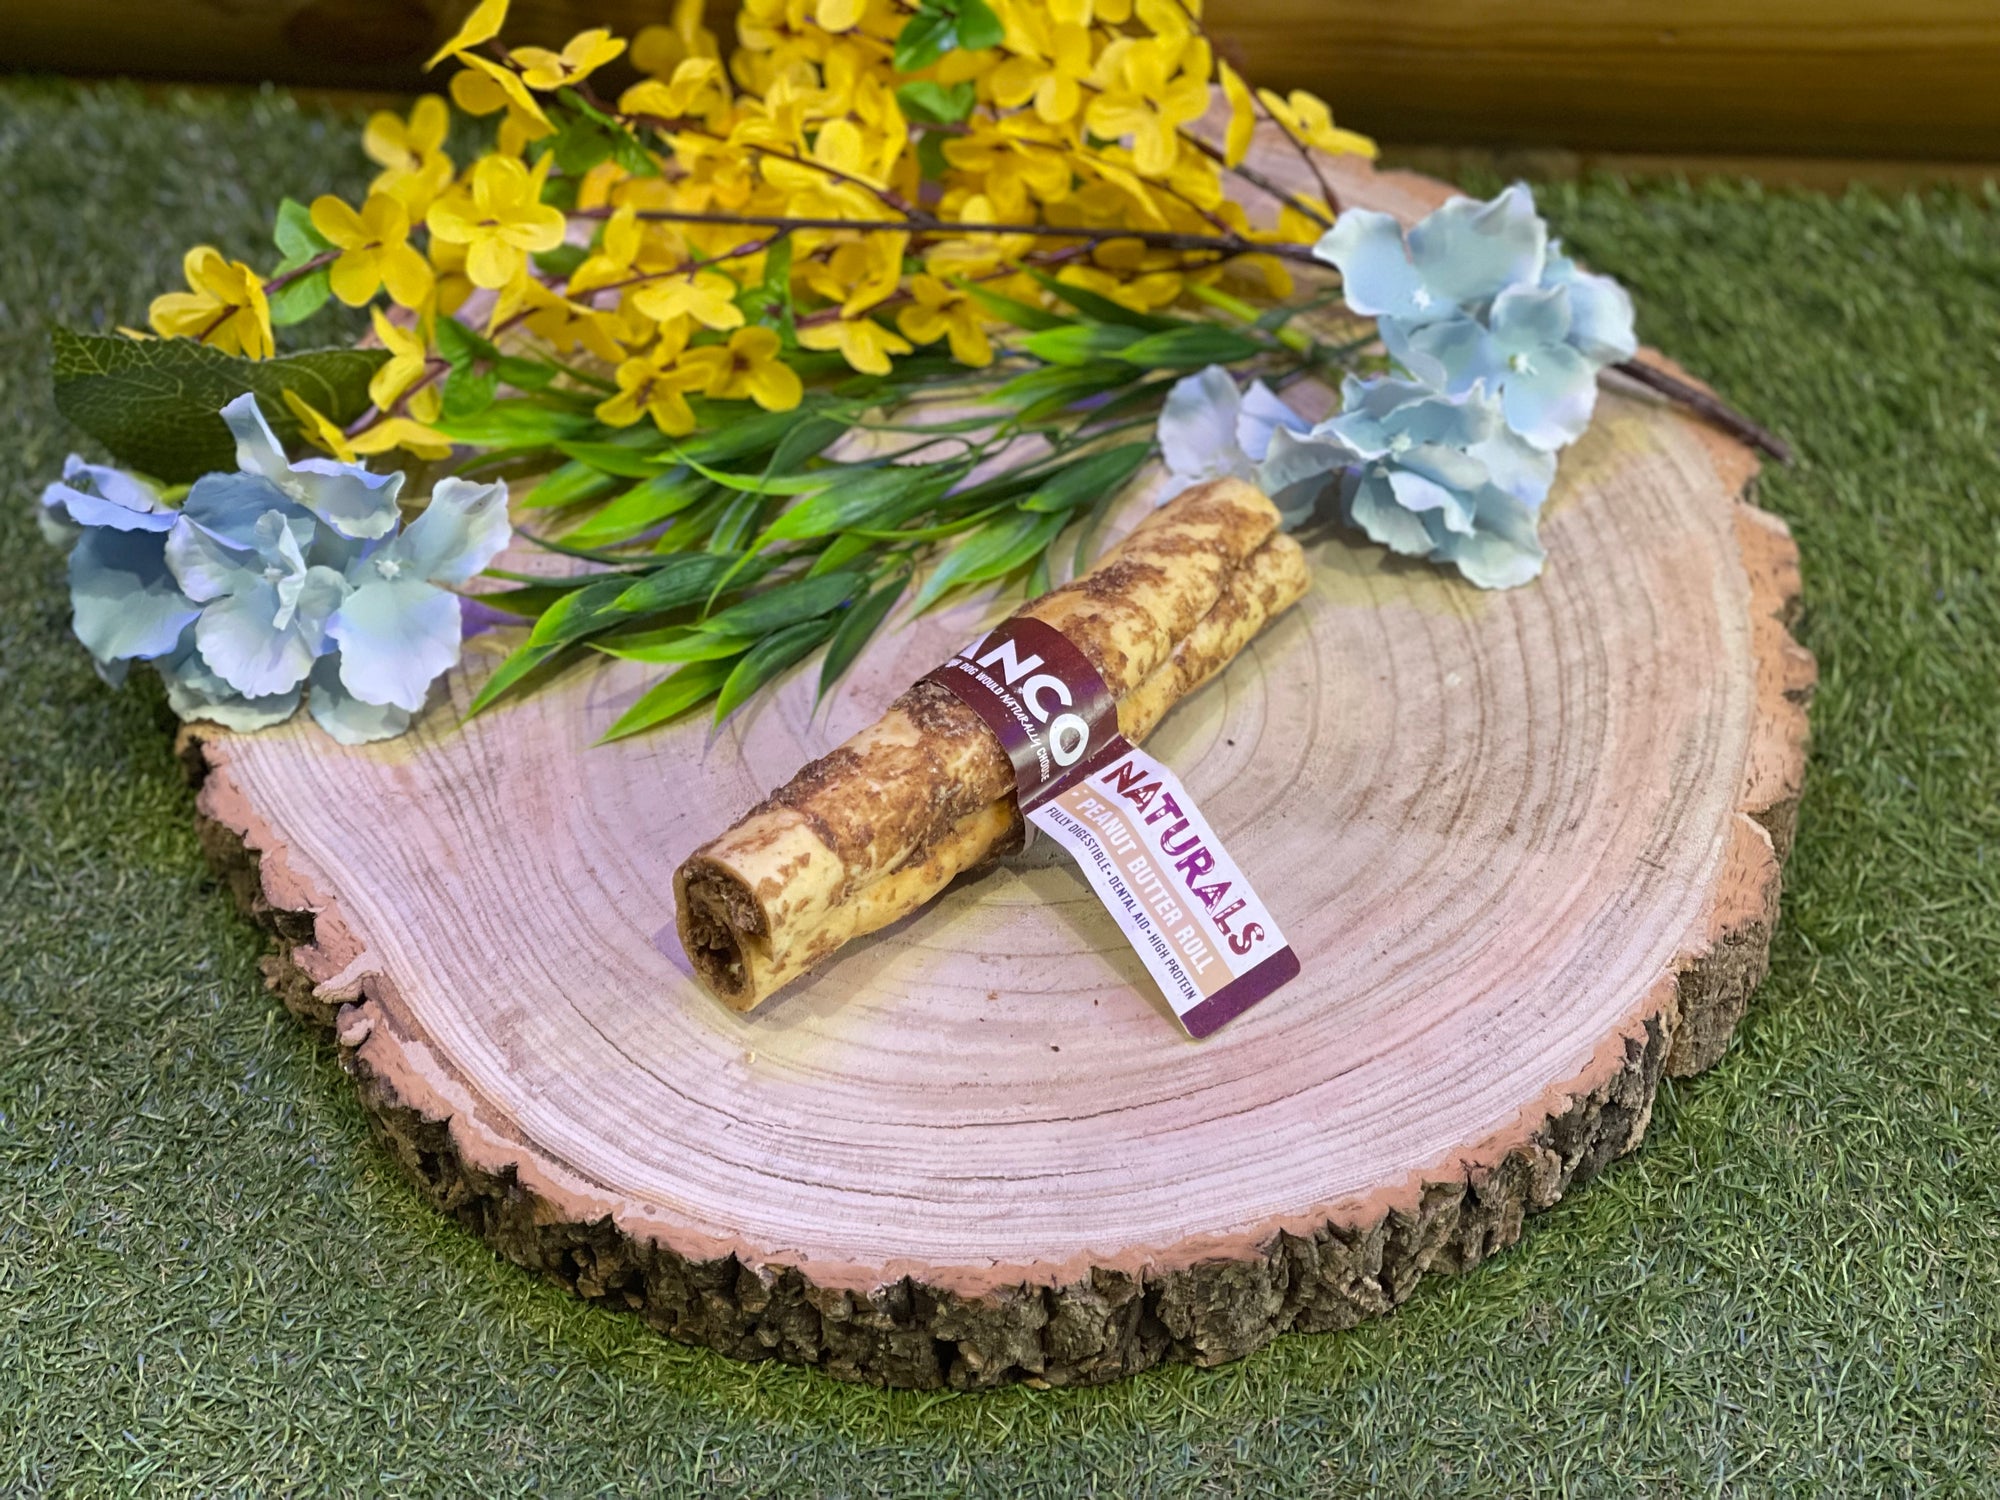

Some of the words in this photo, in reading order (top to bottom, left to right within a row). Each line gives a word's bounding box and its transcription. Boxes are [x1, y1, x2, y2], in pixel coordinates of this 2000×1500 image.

[959, 662, 979, 675] DOG
[975, 671, 1005, 695] WOULD
[1000, 692, 1041, 748] NATURALLY
[1036, 747, 1050, 782] CHOOSE
[1045, 806, 1073, 827] FULLY
[1067, 823, 1111, 872] DIGESTIBLE
[1108, 875, 1137, 913] DENTAL
[1132, 912, 1150, 930] AID
[1148, 933, 1170, 959] HIGH
[1165, 958, 1197, 1000] PROTEIN
[1075, 797, 1137, 855] PEANUT
[1126, 855, 1183, 927] BUTTER
[1174, 924, 1214, 976] ROLL
[1101, 760, 1265, 956] NATURALS
